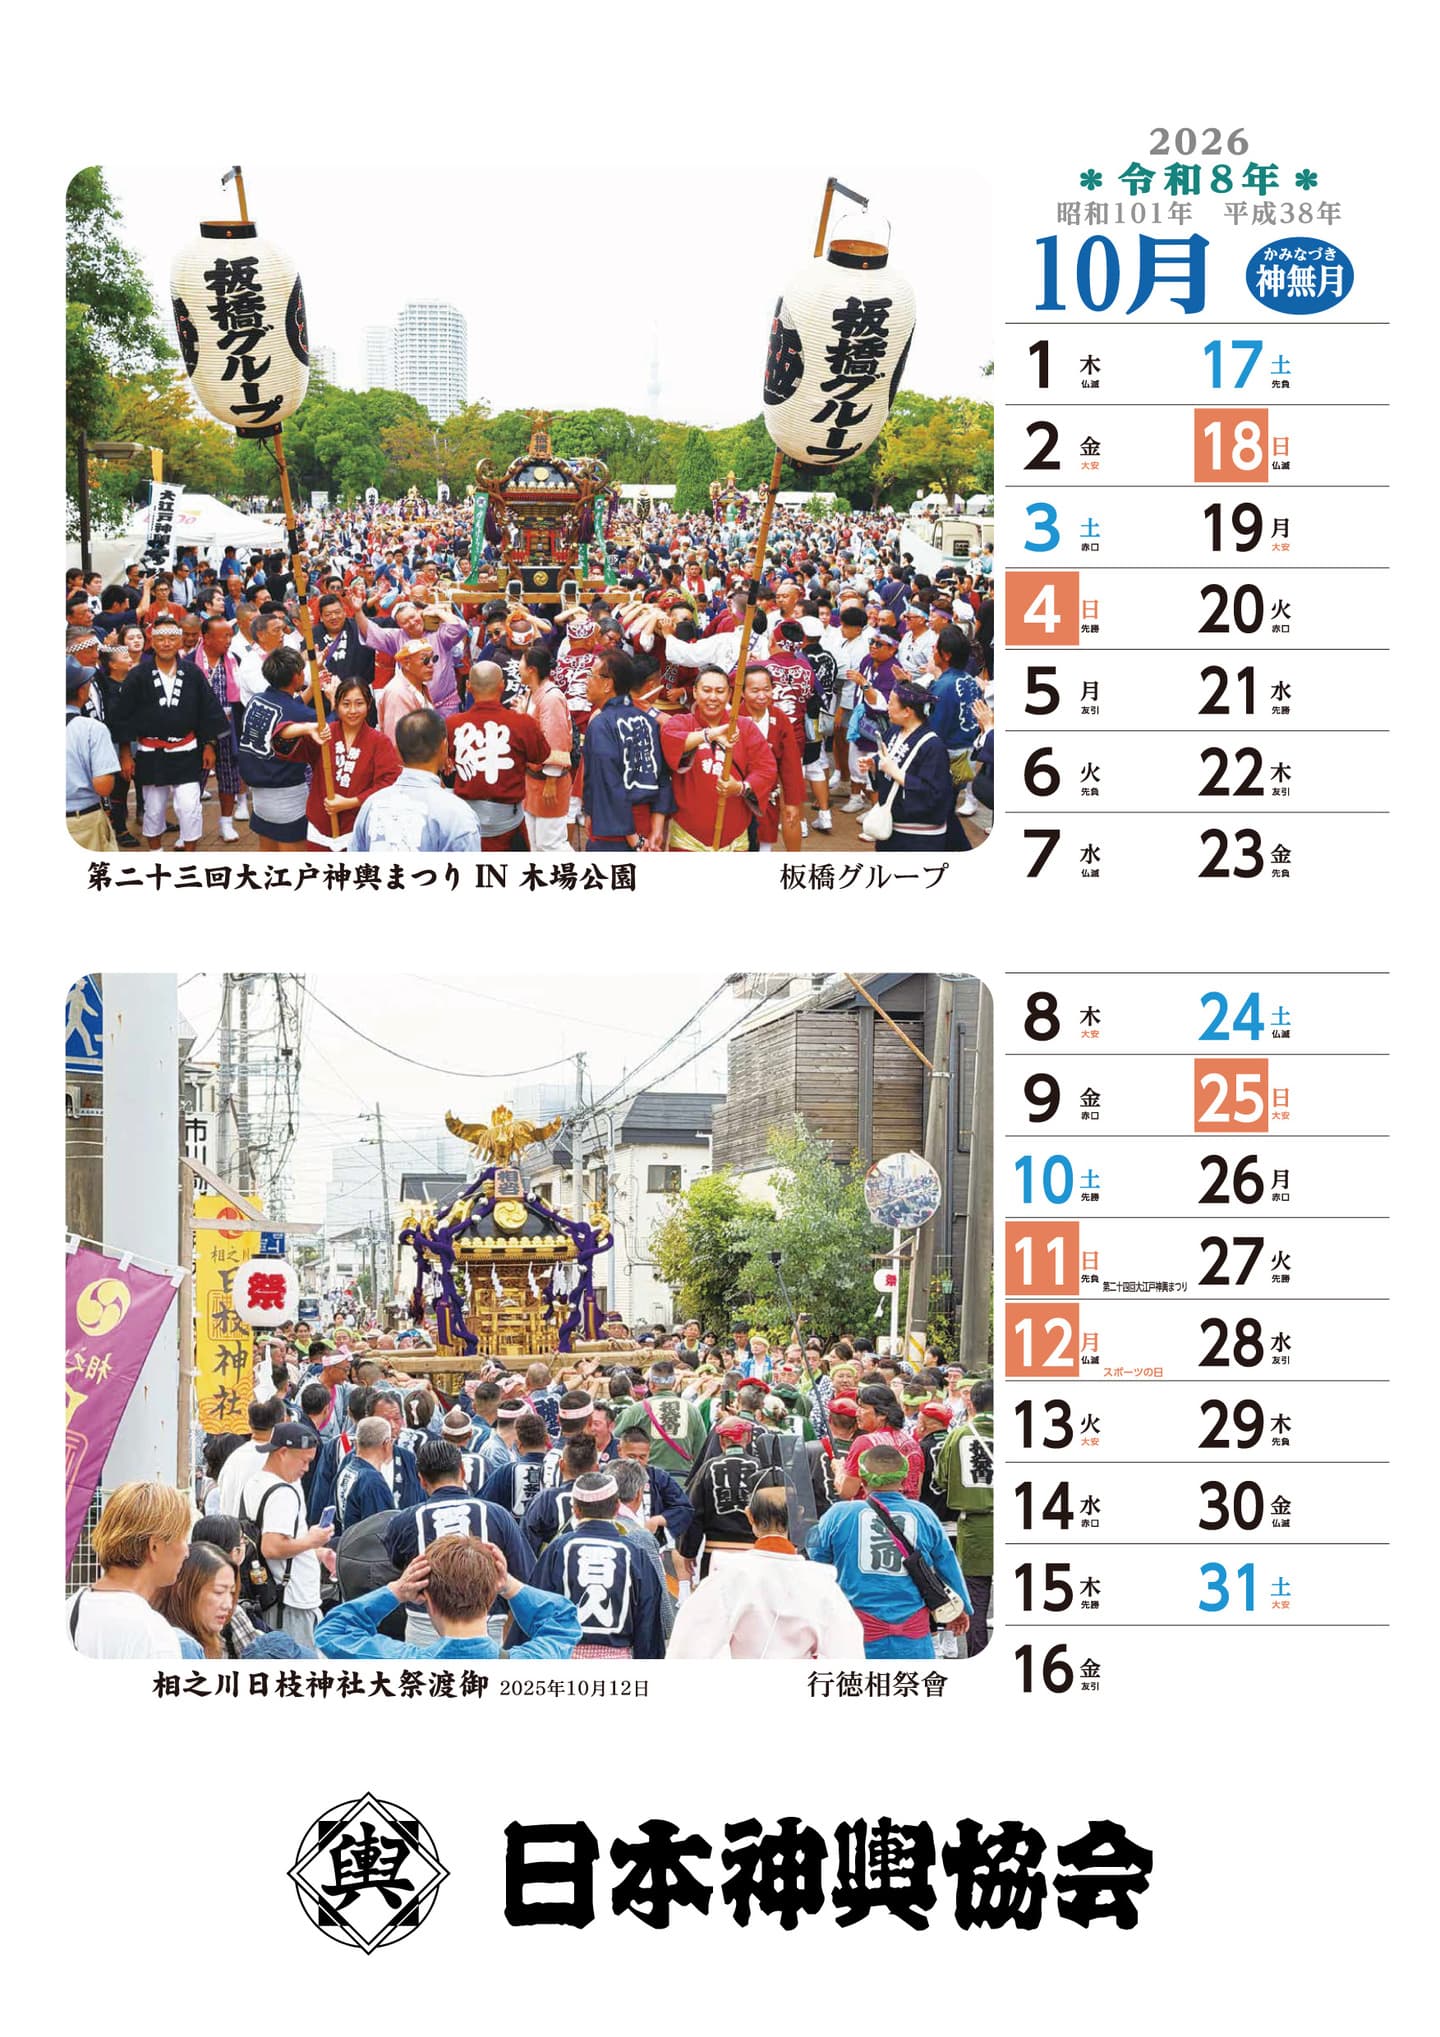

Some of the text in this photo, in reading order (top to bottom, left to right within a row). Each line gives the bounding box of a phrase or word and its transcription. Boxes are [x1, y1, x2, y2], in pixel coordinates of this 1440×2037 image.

[1150, 128, 1248, 155] 2026
[1118, 161, 1279, 196] 令和8年
[1058, 201, 1341, 225] 昭和101年 平成38年
[1264, 247, 1337, 261] かみなづき
[1035, 233, 1210, 315] 10月
[1256, 263, 1344, 298] 神無月
[203, 255, 284, 424] 板橋グループ
[806, 296, 893, 465] 板橋グループ
[1029, 340, 1101, 388] 1 木
[1204, 340, 1291, 388] 17 土
[1081, 380, 1099, 388] 仏滅
[1272, 380, 1290, 388] 先負
[1024, 421, 1101, 470] 2 金
[1204, 421, 1289, 470] 18 日
[1272, 461, 1290, 470] 仏滅
[1024, 502, 1100, 552] 3 土
[1204, 502, 1289, 552] 19 月
[1081, 543, 1099, 551] 赤口
[1272, 543, 1289, 551] 大安
[1024, 585, 1098, 633] 4 日
[1198, 584, 1291, 634] 20 火
[1081, 624, 1099, 633] 先勝
[1272, 624, 1290, 633] 赤口
[1025, 666, 1098, 715] 5 月
[1198, 665, 1291, 714] 21 水
[1081, 706, 1099, 715] 友引
[1272, 706, 1290, 715] 先勝
[454, 721, 515, 784] 絆
[1024, 747, 1100, 797] 6 火
[1198, 747, 1291, 796] 22 木
[1081, 787, 1099, 796] 先負
[1272, 787, 1289, 796] 友引
[1024, 829, 1100, 878] 7 水
[1198, 828, 1291, 878] 23 金
[87, 861, 636, 892] 第二十三回大江戸神輿まつり IN 木場公園
[780, 862, 949, 890] 板橋グループ
[1081, 869, 1099, 877] 仏滅
[1272, 869, 1290, 878] 先負
[1024, 991, 1101, 1041] 8 木
[1198, 991, 1291, 1040] 24 土
[1081, 1030, 1099, 1038] 大安
[1272, 1030, 1290, 1038] 仏滅
[1024, 1073, 1100, 1123] 9 金
[1081, 1111, 1099, 1120] 赤口
[1199, 1073, 1288, 1123] 25 日
[1272, 1112, 1289, 1120] 大安
[1015, 1154, 1100, 1204] 10 土
[1198, 1154, 1289, 1204] 26 月
[1081, 1193, 1099, 1201] 先勝
[1272, 1193, 1289, 1201] 赤口
[1015, 1237, 1098, 1285] 11 日
[1198, 1236, 1291, 1285] 27 火
[248, 1272, 287, 1310] 祭
[1081, 1274, 1099, 1283] 先負
[1272, 1274, 1290, 1283] 先勝
[1015, 1318, 1098, 1366] 12 月
[1198, 1318, 1291, 1367] 28 水
[1081, 1356, 1099, 1364] 仏滅
[1104, 1367, 1163, 1377] スポーツの日
[1272, 1356, 1289, 1365] 友引
[1015, 1399, 1100, 1449] 13 火
[1082, 1437, 1099, 1446] 大安
[1198, 1399, 1291, 1449] 29 木
[1272, 1437, 1290, 1446] 先負
[1015, 1481, 1100, 1530] 14 水
[1199, 1481, 1291, 1530] 30 金
[1272, 1519, 1290, 1527] 仏滅
[1081, 1519, 1099, 1528] 赤口
[1015, 1563, 1101, 1612] 15 木
[1081, 1600, 1099, 1609] 先勝
[1199, 1562, 1291, 1612] 31 土
[1272, 1601, 1289, 1609] 大安
[152, 1669, 648, 1699] 相之川日枝神社大祭渡御 2025年10月12日
[1015, 1643, 1101, 1693] 16 金
[1081, 1682, 1099, 1691] 友引
[504, 1816, 1153, 1931] 日本神輿協会
